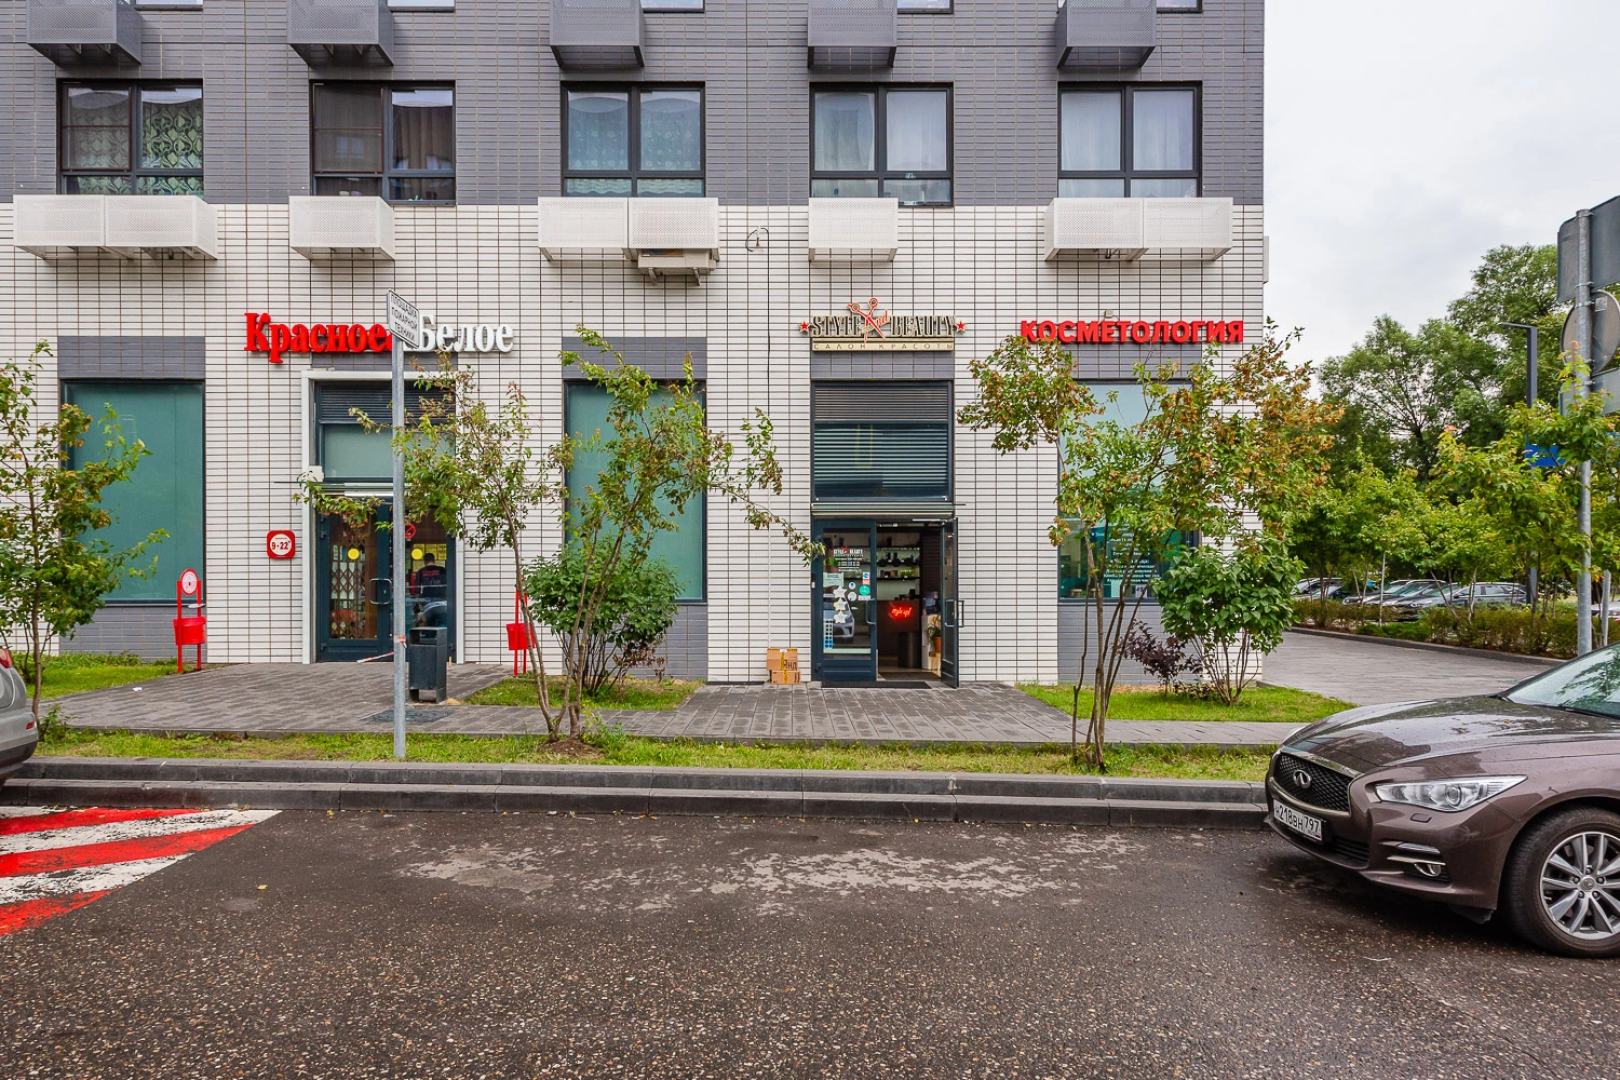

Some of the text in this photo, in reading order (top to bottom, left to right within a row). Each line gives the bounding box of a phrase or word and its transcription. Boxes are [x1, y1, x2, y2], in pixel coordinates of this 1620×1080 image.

[391, 306, 417, 332] ПОЖАРНОЙ
[812, 315, 862, 337] STYLE
[890, 315, 954, 337] BEAUTY
[1021, 320, 1243, 343] КОСМЕТОЛОГИЯ
[1304, 815, 1320, 833] 797
